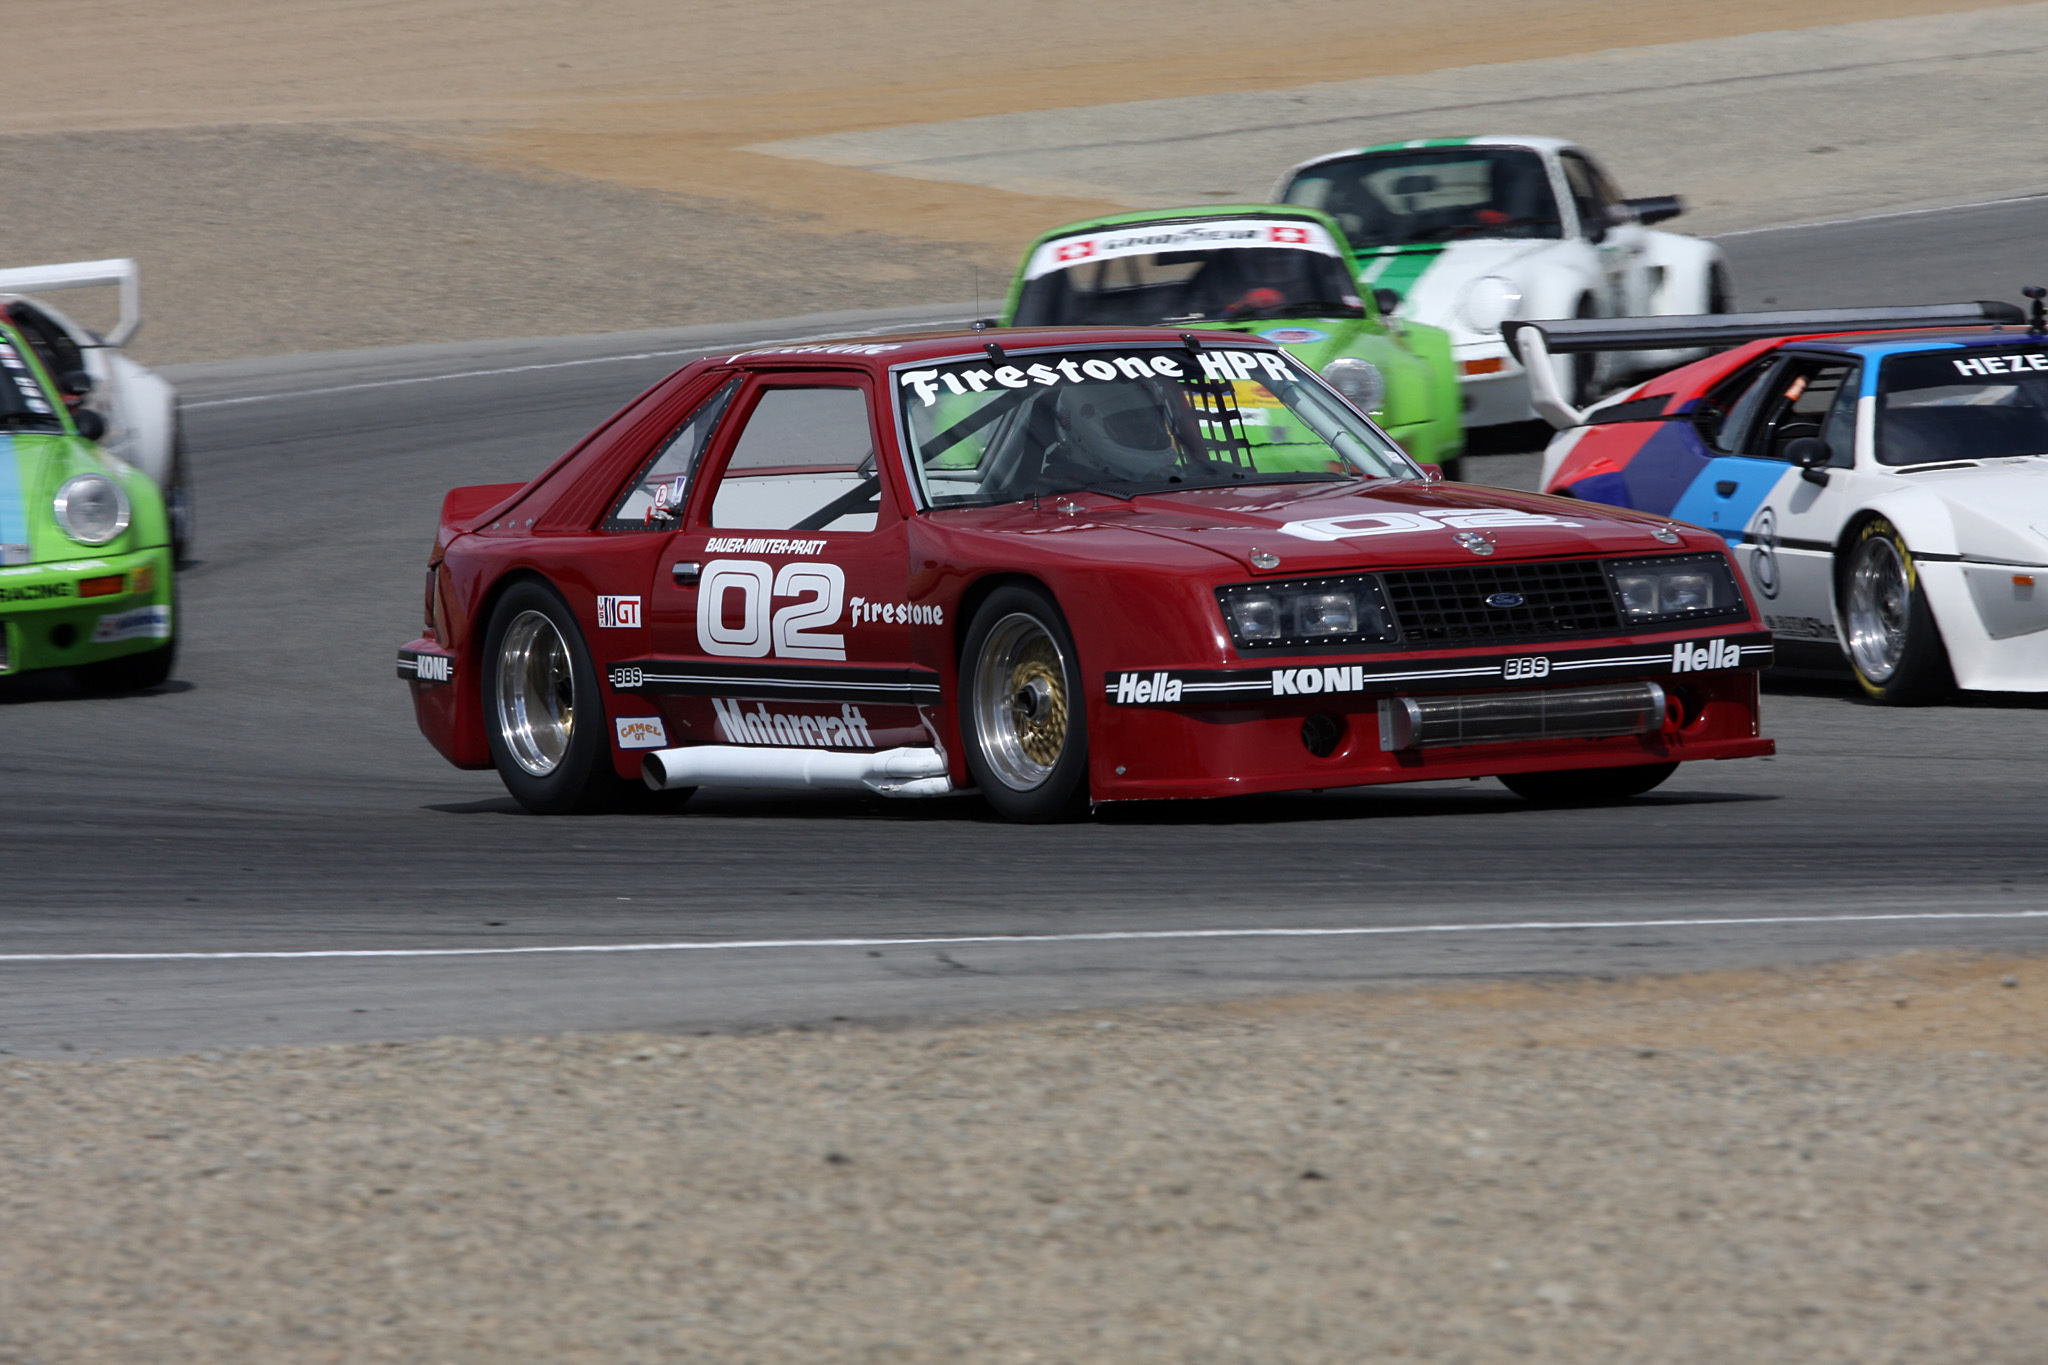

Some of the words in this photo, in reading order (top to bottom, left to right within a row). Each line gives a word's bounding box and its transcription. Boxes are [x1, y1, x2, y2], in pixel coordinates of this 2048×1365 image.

[901, 355, 1184, 406] Firestone
[1198, 350, 1299, 382] HPR
[1952, 353, 2048, 376] HEZE
[1277, 508, 1584, 541] 02
[617, 600, 639, 624] GT
[696, 559, 847, 661] 02
[849, 597, 944, 628] Firestone
[417, 655, 448, 681] KONI
[1504, 656, 1550, 680] BBS
[1672, 639, 1741, 673] Hella
[614, 667, 643, 688] BBS
[1117, 672, 1183, 703] Hella
[1272, 666, 1364, 696] KONI
[620, 723, 662, 738] CAMEL
[711, 698, 875, 747] Motorcraft
